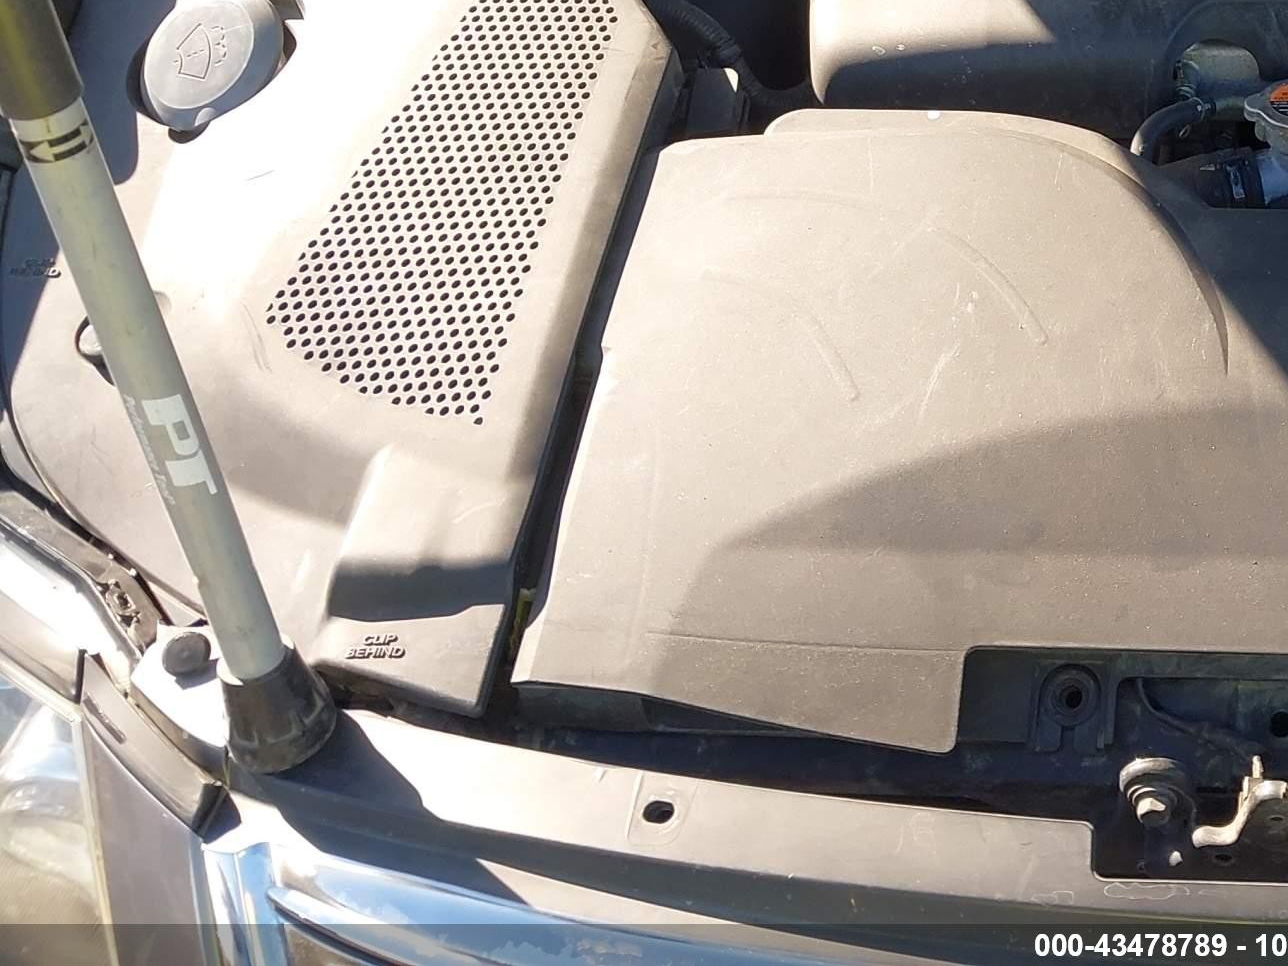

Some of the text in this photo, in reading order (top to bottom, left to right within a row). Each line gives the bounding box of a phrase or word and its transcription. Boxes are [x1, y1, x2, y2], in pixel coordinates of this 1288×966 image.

[141, 393, 218, 495] PT
[363, 633, 399, 646] CLIP
[345, 646, 406, 660] BEHIND
